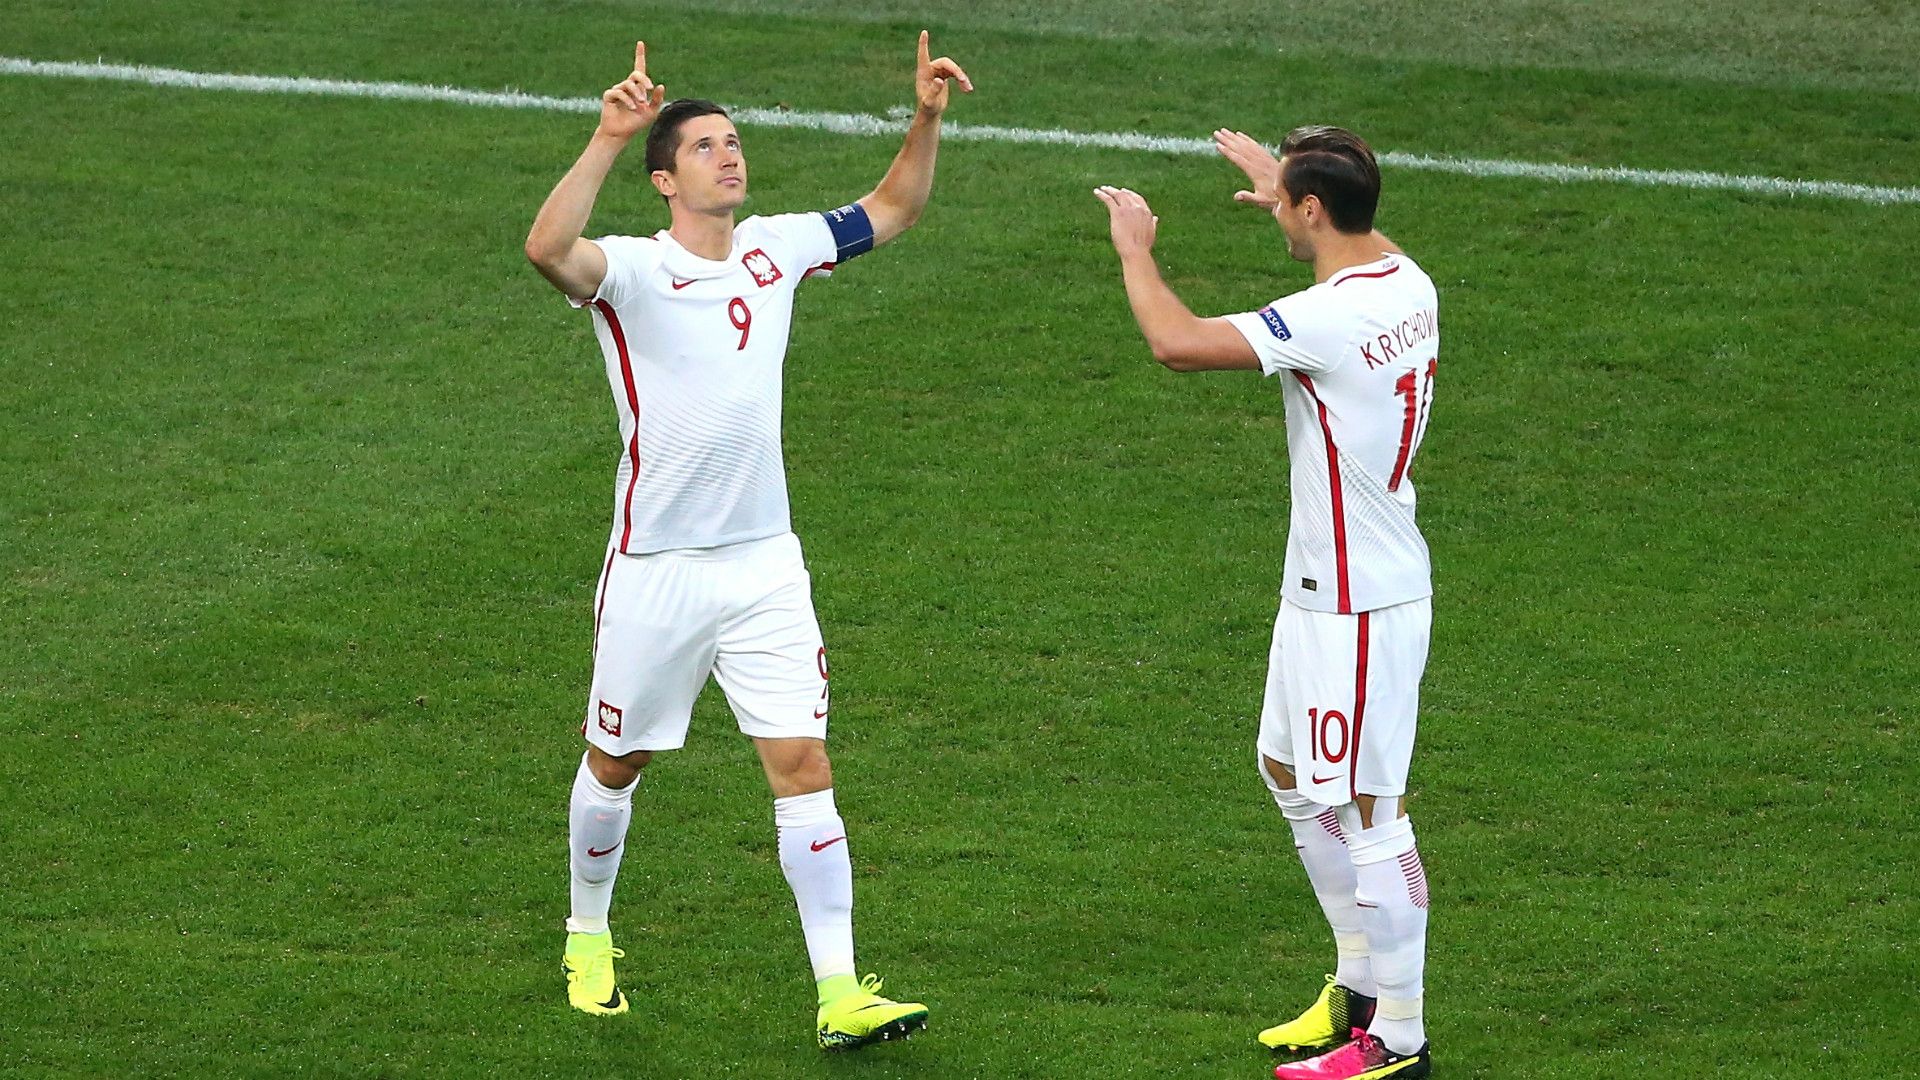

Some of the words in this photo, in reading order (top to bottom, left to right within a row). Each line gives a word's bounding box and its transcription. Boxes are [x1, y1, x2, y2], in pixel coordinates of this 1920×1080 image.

[728, 297, 752, 351] 9
[1264, 311, 1288, 340] RESPECT
[1308, 707, 1349, 764] 10
